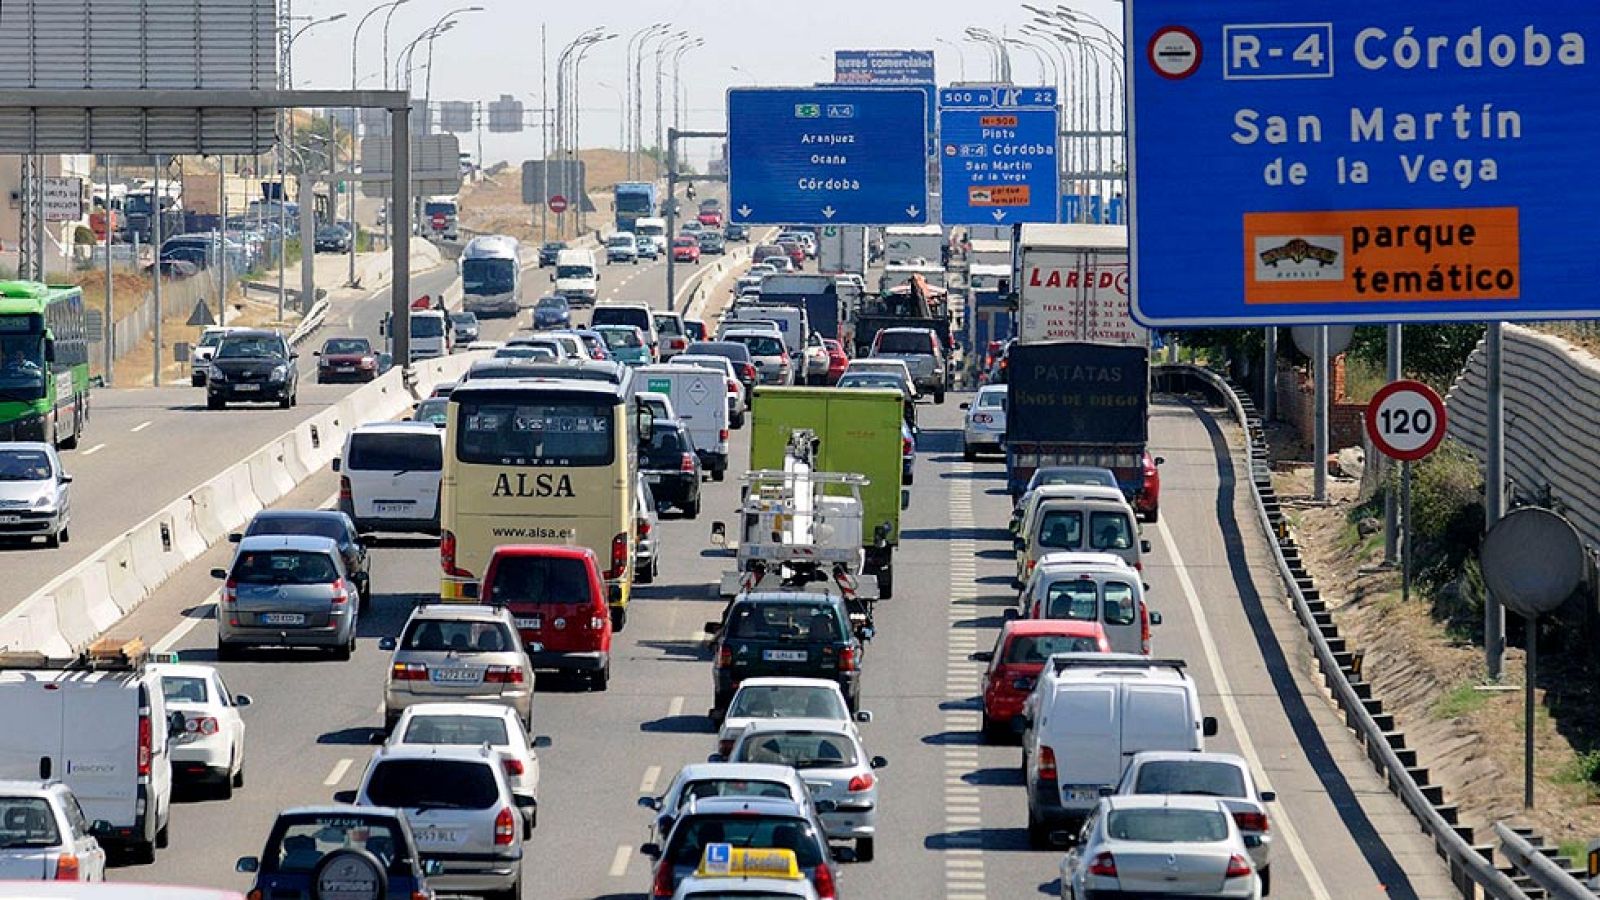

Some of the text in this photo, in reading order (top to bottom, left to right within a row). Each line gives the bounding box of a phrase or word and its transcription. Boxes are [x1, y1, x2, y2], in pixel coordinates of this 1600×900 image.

[1231, 25, 1586, 70] R-4 Córdoba
[945, 92, 989, 102] 500 m
[1034, 92, 1053, 102] 22
[829, 105, 852, 117] A-4
[1230, 103, 1521, 144] San Martín
[801, 133, 855, 146] Aranjuez
[982, 128, 1015, 139] Pinto
[993, 143, 1054, 156] Córdoba
[810, 154, 847, 165] Ocaña
[965, 161, 988, 171] San
[1264, 154, 1499, 189] de la Vega
[798, 177, 860, 190] Córdoba
[1351, 223, 1477, 254] parque
[1352, 264, 1515, 294] temático
[1034, 365, 1122, 382] PATATAS
[1062, 392, 1083, 406] DE
[1088, 392, 1139, 406] DIEGO
[1380, 408, 1431, 434] 120
[492, 473, 576, 497] ALSA
[711, 847, 725, 861] L
